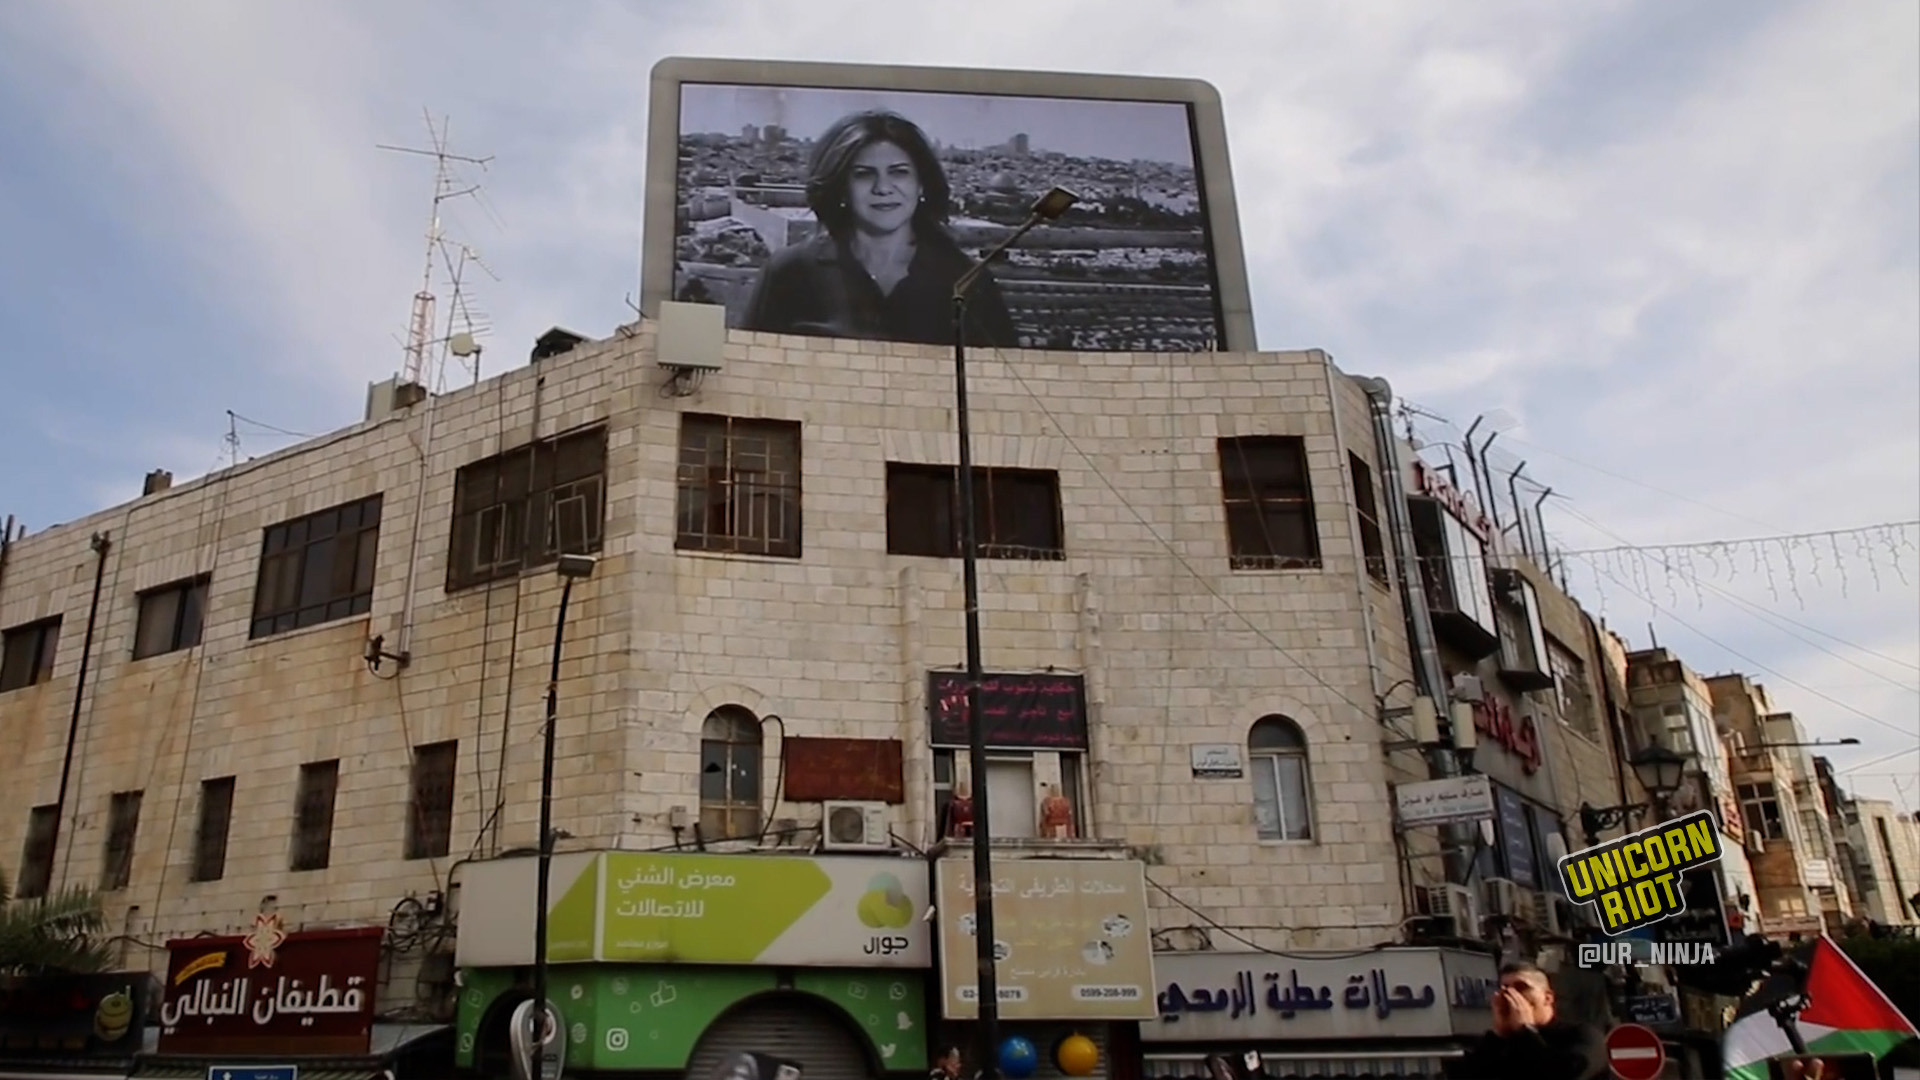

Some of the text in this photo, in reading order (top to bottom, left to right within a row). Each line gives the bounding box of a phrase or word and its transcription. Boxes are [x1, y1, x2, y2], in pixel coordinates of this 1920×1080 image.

[678, 872, 736, 890] معرض
[616, 899, 705, 919] للاتصالات
[863, 935, 909, 955] جوال
[160, 974, 364, 1035] قطيفان النبالي
[1157, 970, 1257, 1023] الرمحي
[1265, 970, 1332, 1019] عطية
[1344, 969, 1435, 1020] محلات
